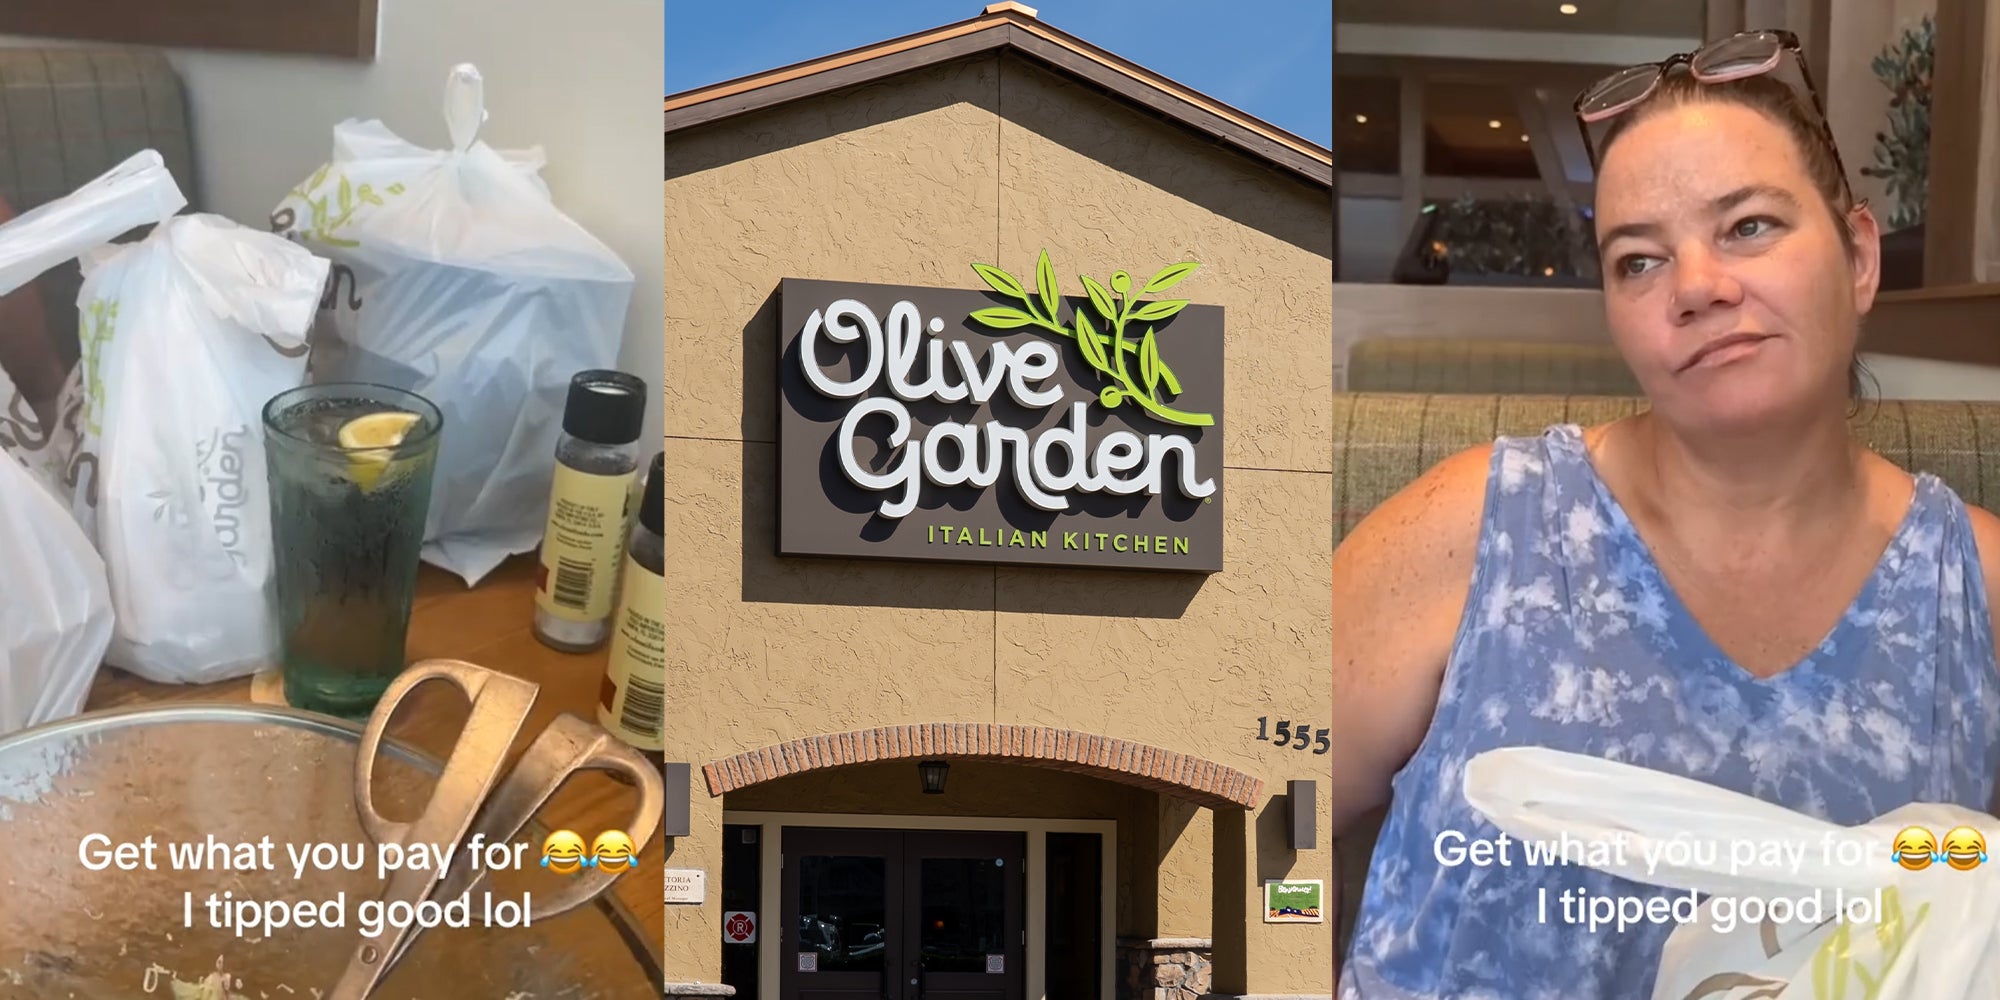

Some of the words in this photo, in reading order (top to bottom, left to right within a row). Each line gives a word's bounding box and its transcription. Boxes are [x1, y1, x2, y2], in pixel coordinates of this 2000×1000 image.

[801, 299, 1065, 408] Olive
[839, 397, 1217, 519] Garden
[928, 525, 1047, 548] ITALIAN
[1063, 532, 1190, 554] KITCHEN
[1256, 716, 1331, 755] 1555
[664, 876, 692, 884] TORIA
[737, 922, 744, 932] R
